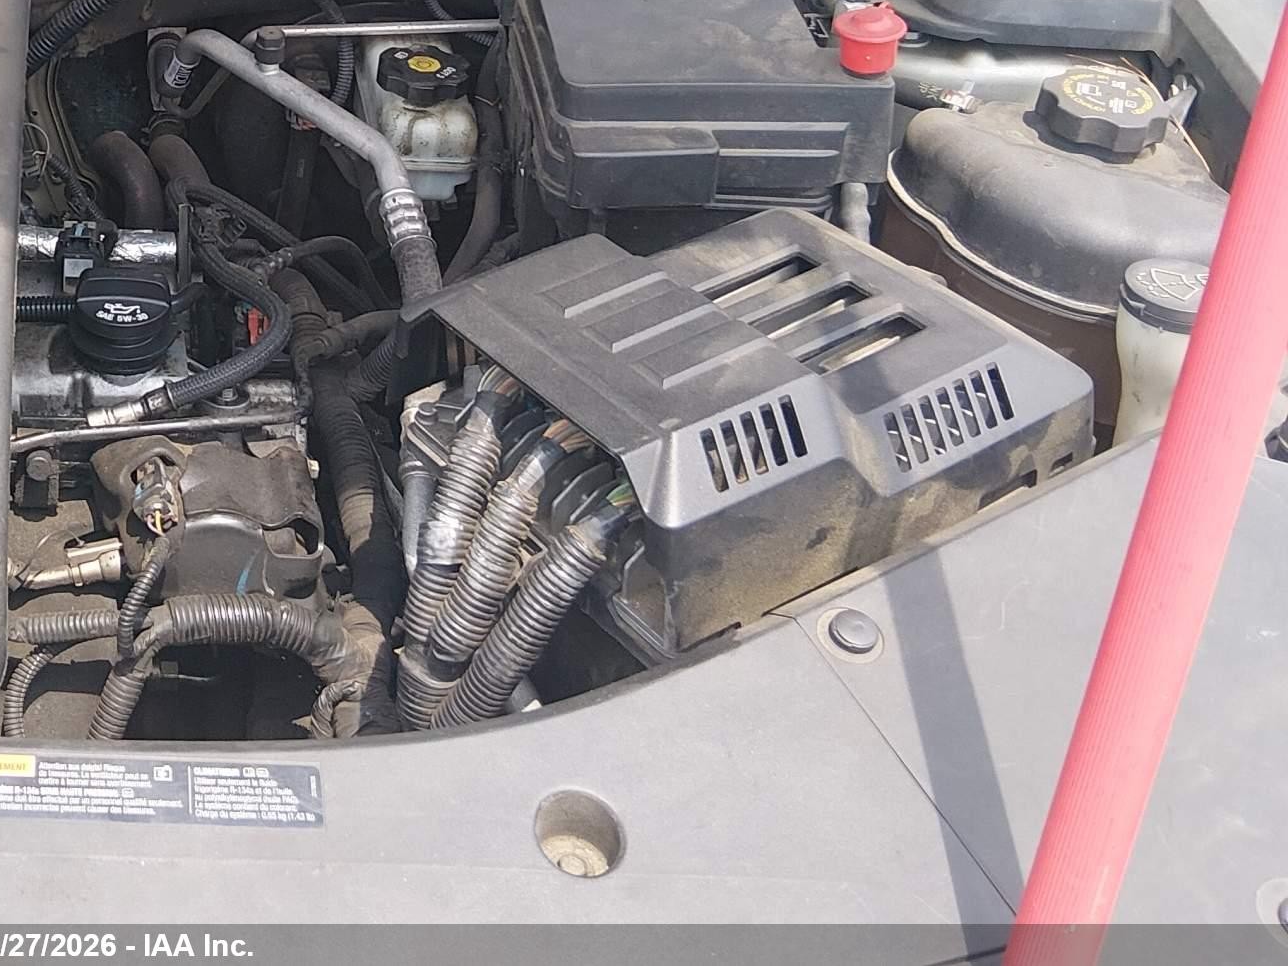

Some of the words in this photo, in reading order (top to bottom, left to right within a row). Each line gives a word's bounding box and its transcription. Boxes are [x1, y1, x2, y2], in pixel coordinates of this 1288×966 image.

[96, 310, 115, 321] SAE
[117, 313, 149, 322] 5W-30
[38, 762, 67, 770] Attention
[230, 786, 254, 795] R-134a
[262, 787, 272, 795] de
[194, 801, 204, 809] Le
[260, 804, 269, 812] du
[195, 809, 218, 820] Charge
[219, 810, 229, 818] du
[278, 812, 288, 822] kg
